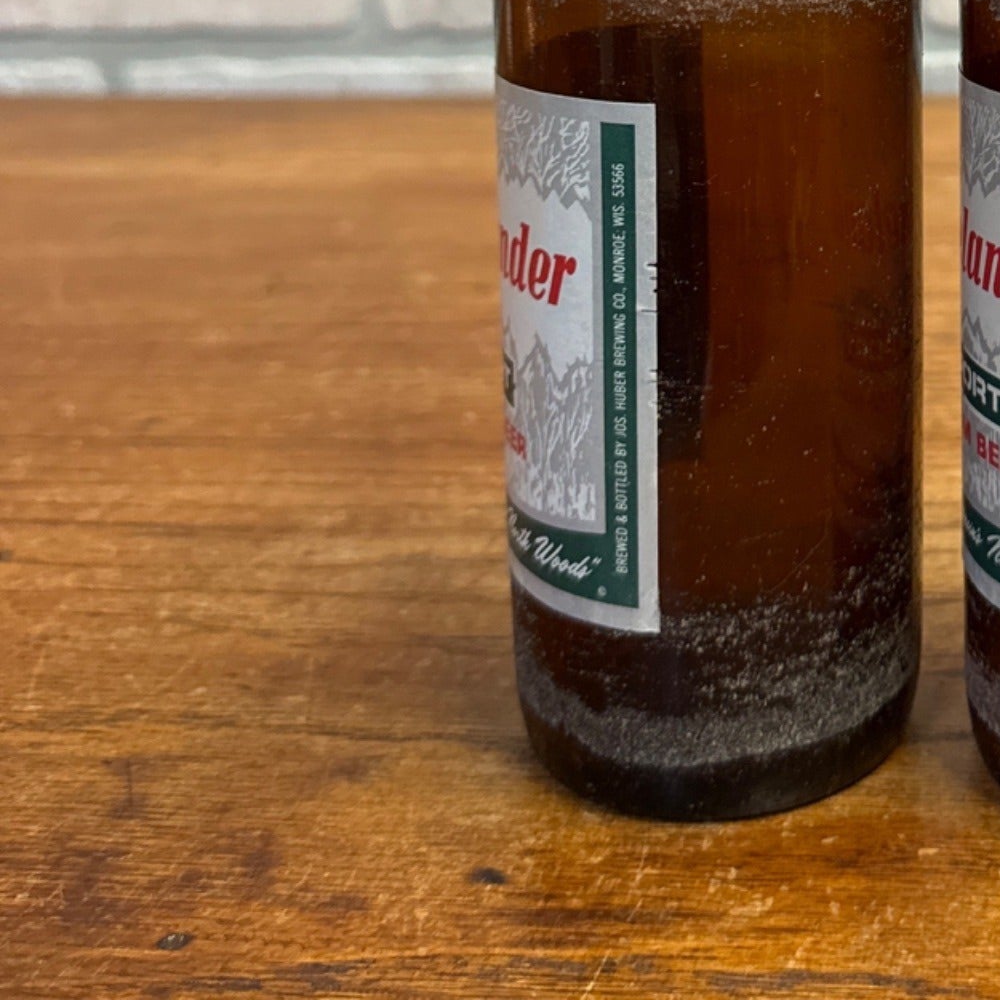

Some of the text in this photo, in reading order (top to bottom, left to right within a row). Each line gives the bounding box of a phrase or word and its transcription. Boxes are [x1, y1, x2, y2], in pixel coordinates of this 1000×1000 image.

[611, 163, 625, 198] 53566
[613, 313, 626, 367] BREWING
[614, 371, 627, 411] HUBER
[614, 441, 627, 457] BY
[615, 460, 629, 511] BOTTLED
[615, 514, 628, 524] &
[615, 527, 628, 575] BREWED
